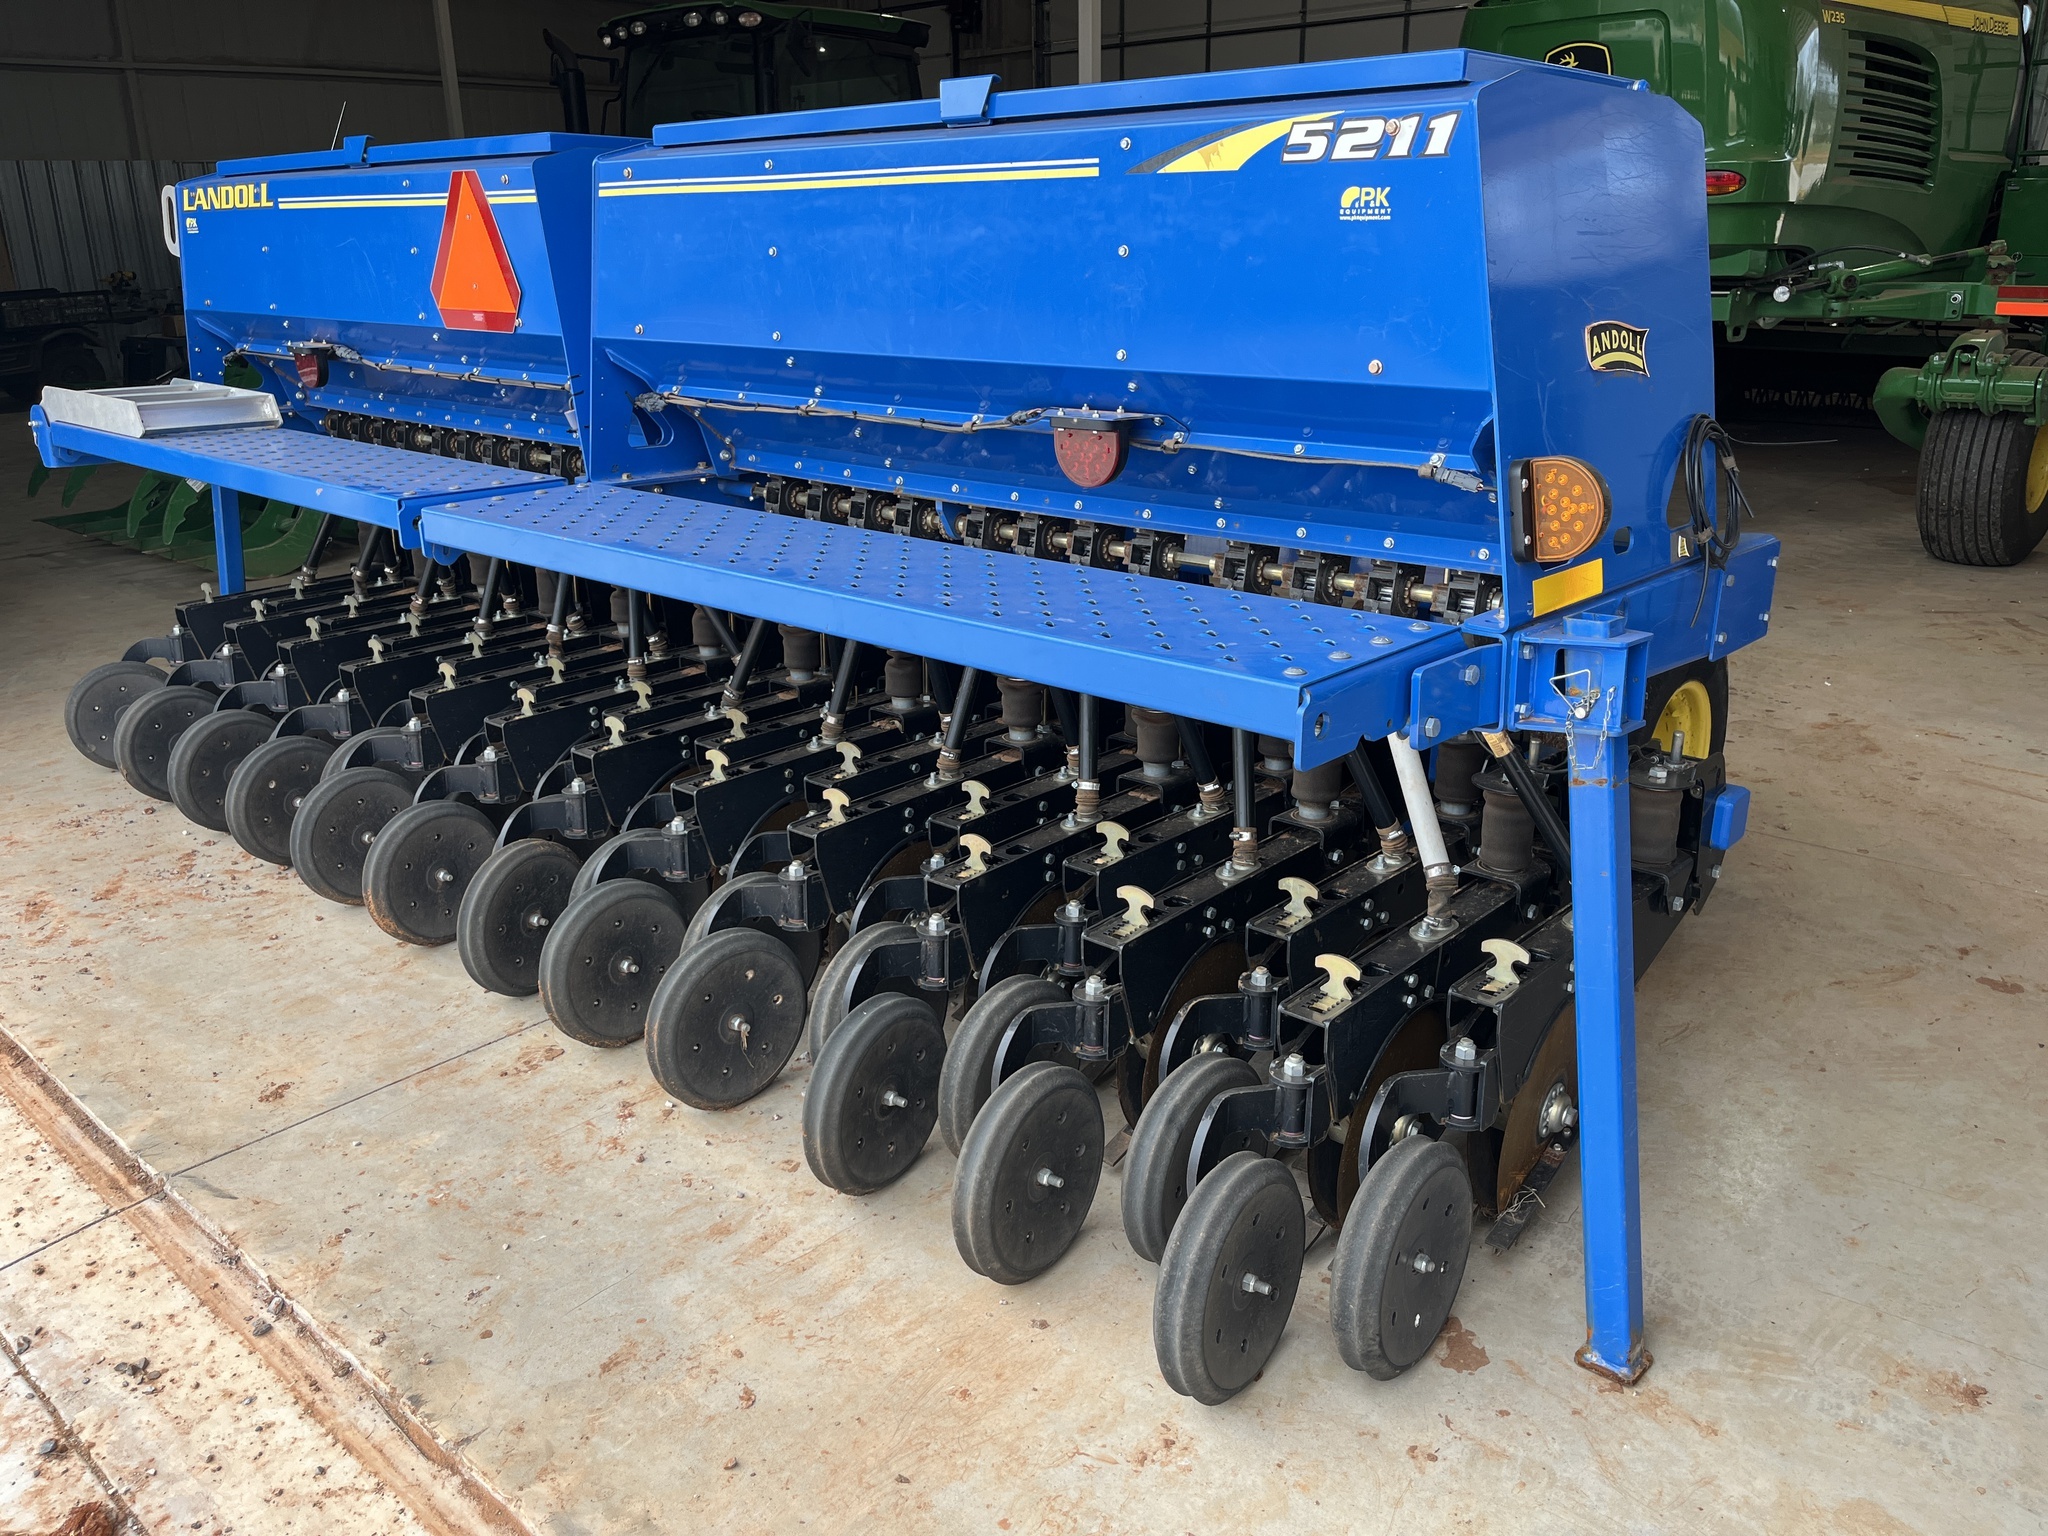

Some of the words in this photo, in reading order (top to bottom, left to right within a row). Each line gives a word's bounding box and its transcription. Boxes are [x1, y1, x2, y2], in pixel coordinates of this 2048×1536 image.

[1822, 9, 1846, 24] W235
[1971, 14, 1989, 33] JOHN
[1989, 16, 2009, 36] DEERE
[1281, 110, 1462, 164] 5211
[183, 182, 274, 212] LANDOLL
